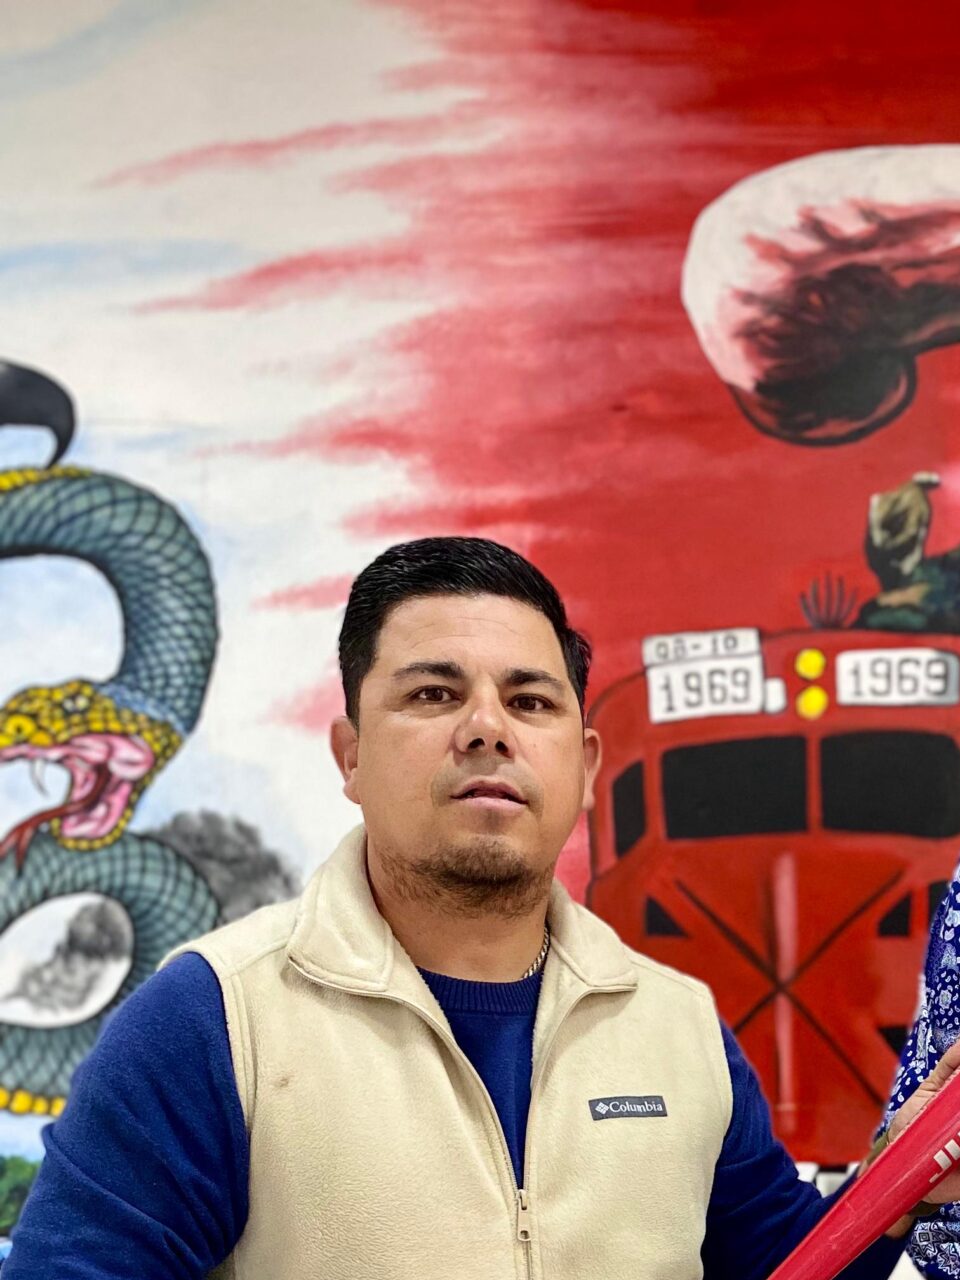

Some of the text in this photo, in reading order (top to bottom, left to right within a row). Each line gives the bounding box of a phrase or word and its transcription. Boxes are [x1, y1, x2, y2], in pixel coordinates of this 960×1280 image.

[659, 667, 752, 713] 1969
[850, 656, 951, 698] 1969
[609, 1101, 663, 1113] Columbia
